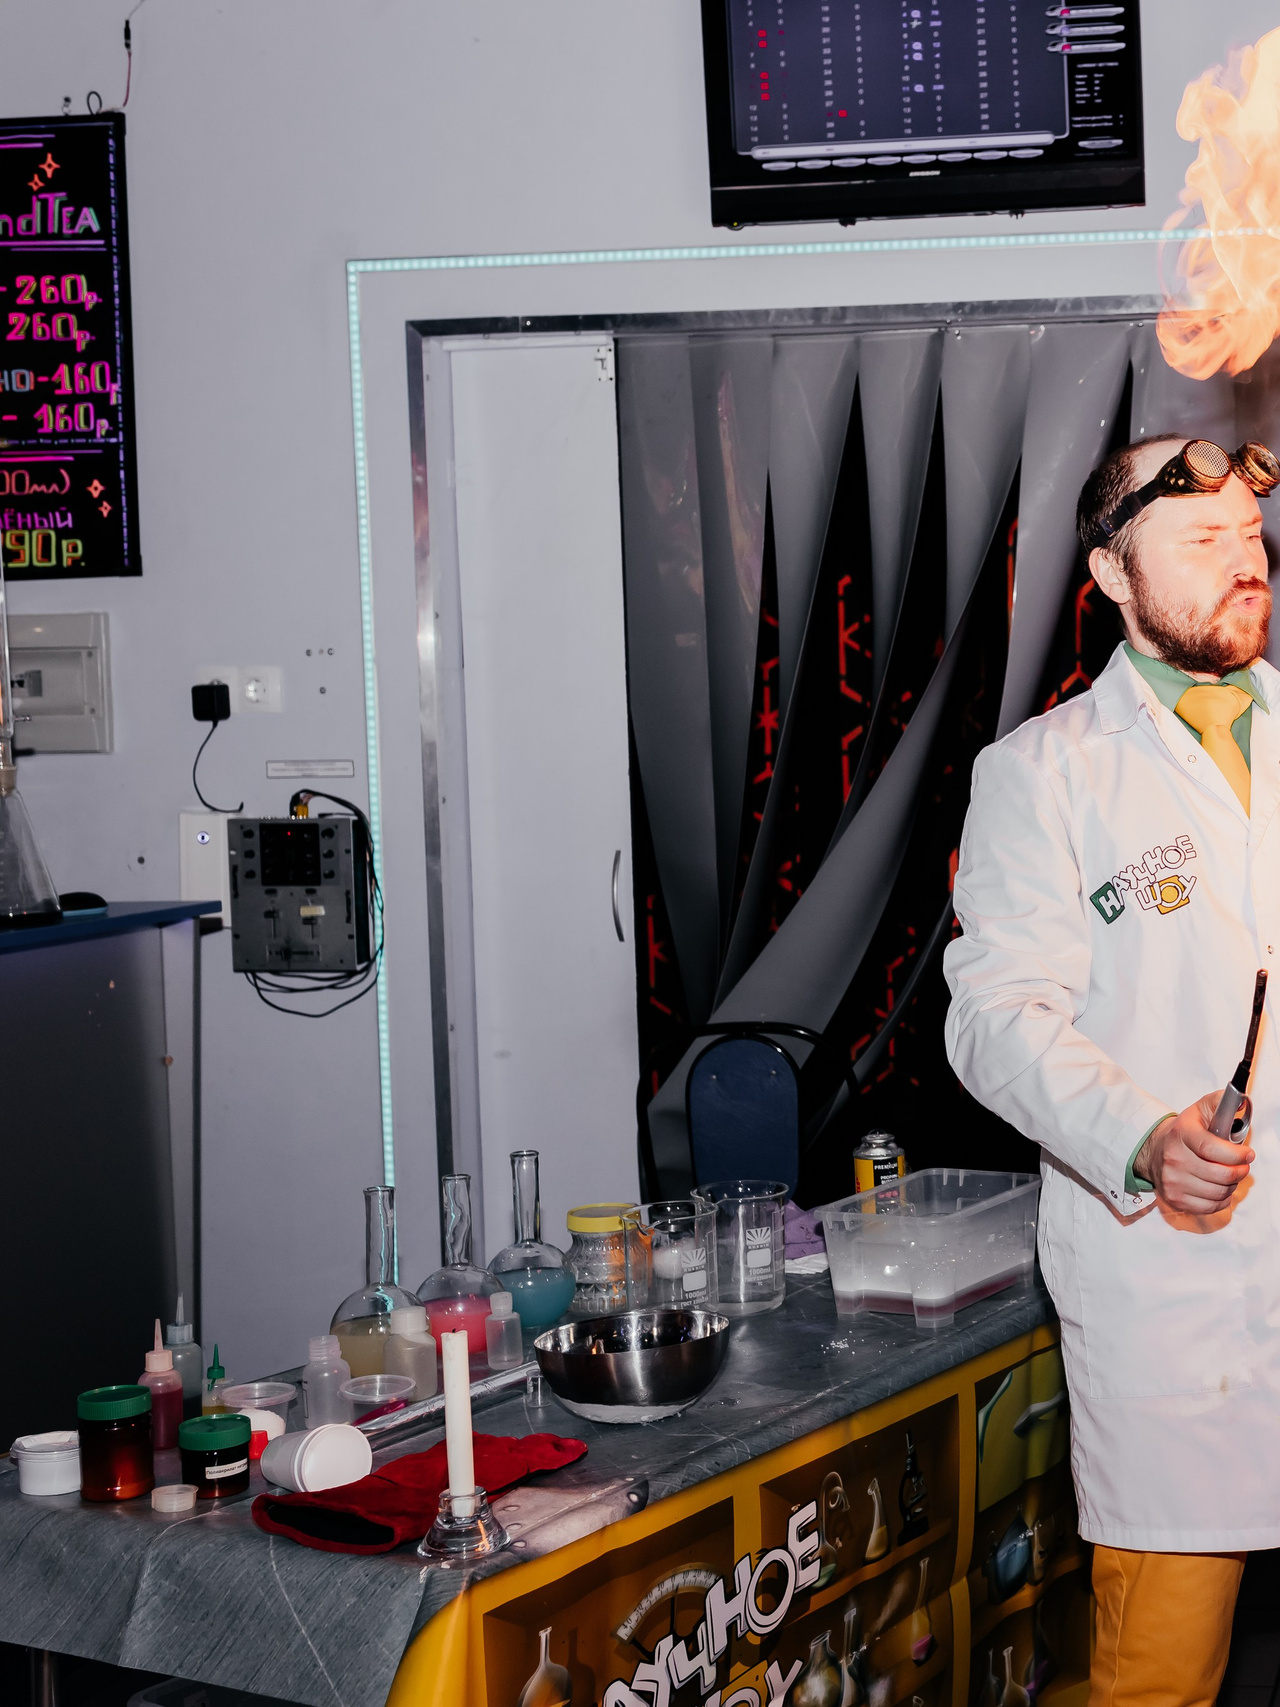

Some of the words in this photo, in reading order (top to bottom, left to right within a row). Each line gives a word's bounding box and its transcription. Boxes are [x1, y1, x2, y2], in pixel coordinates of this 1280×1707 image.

[0, 508, 73, 530] ЁНЫЙ
[1098, 834, 1197, 918] НАУЧНОЕ
[1135, 875, 1198, 911] ШОУ
